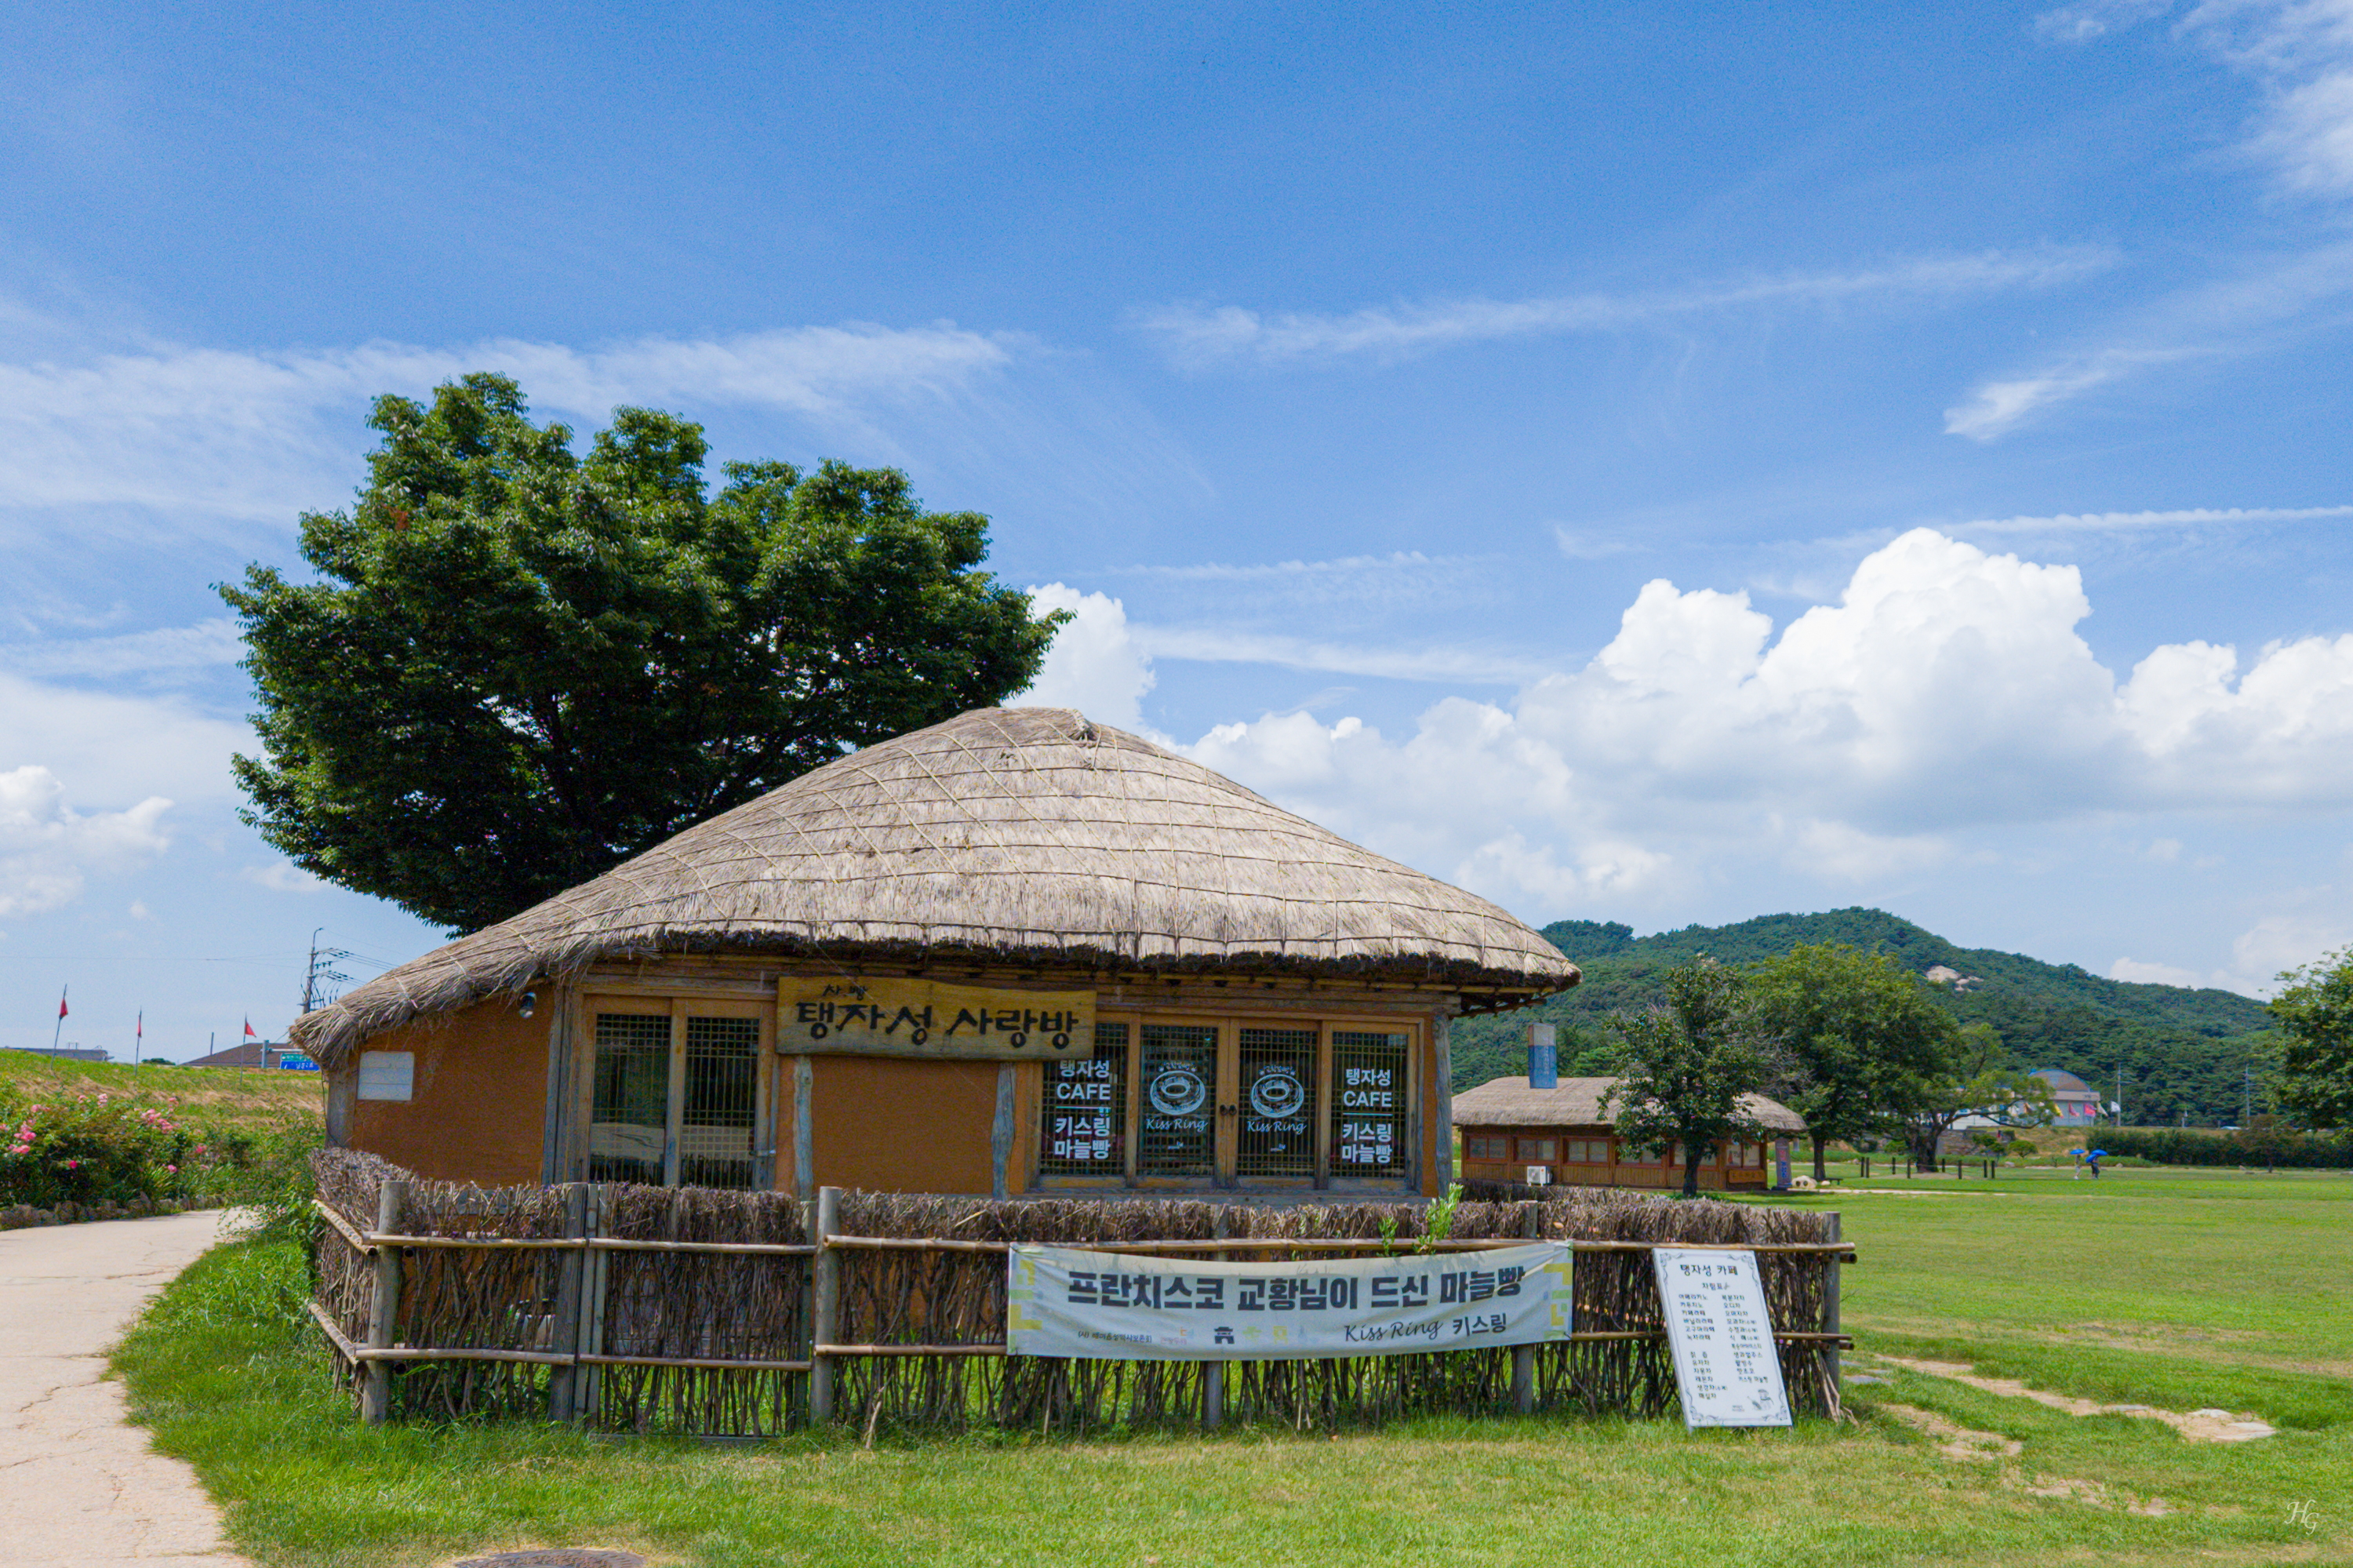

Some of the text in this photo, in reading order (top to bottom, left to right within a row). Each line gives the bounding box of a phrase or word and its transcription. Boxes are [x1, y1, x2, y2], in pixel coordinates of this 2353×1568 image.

[796, 1002, 1079, 1050] 탱자성 사랑방
[1060, 1060, 1109, 1078] 탱자성
[1346, 1068, 1391, 1086] 탱자성
[1056, 1082, 1111, 1100] CAFE
[1344, 1090, 1392, 1108] CAFE
[1055, 1116, 1111, 1137] 키스링
[1146, 1119, 1208, 1133] Kiss Ring
[1247, 1121, 1307, 1135] Kiss Ring
[1342, 1122, 1392, 1142] 키스링
[1054, 1139, 1111, 1159] 마늘빵
[1342, 1144, 1393, 1163] 마늘빵
[1717, 1264, 1738, 1275] 카페
[1068, 1266, 1526, 1311] 프란치스코 교황님이 드신 마늘빵
[1344, 1312, 1507, 1342] Kiss Ring 키스링
